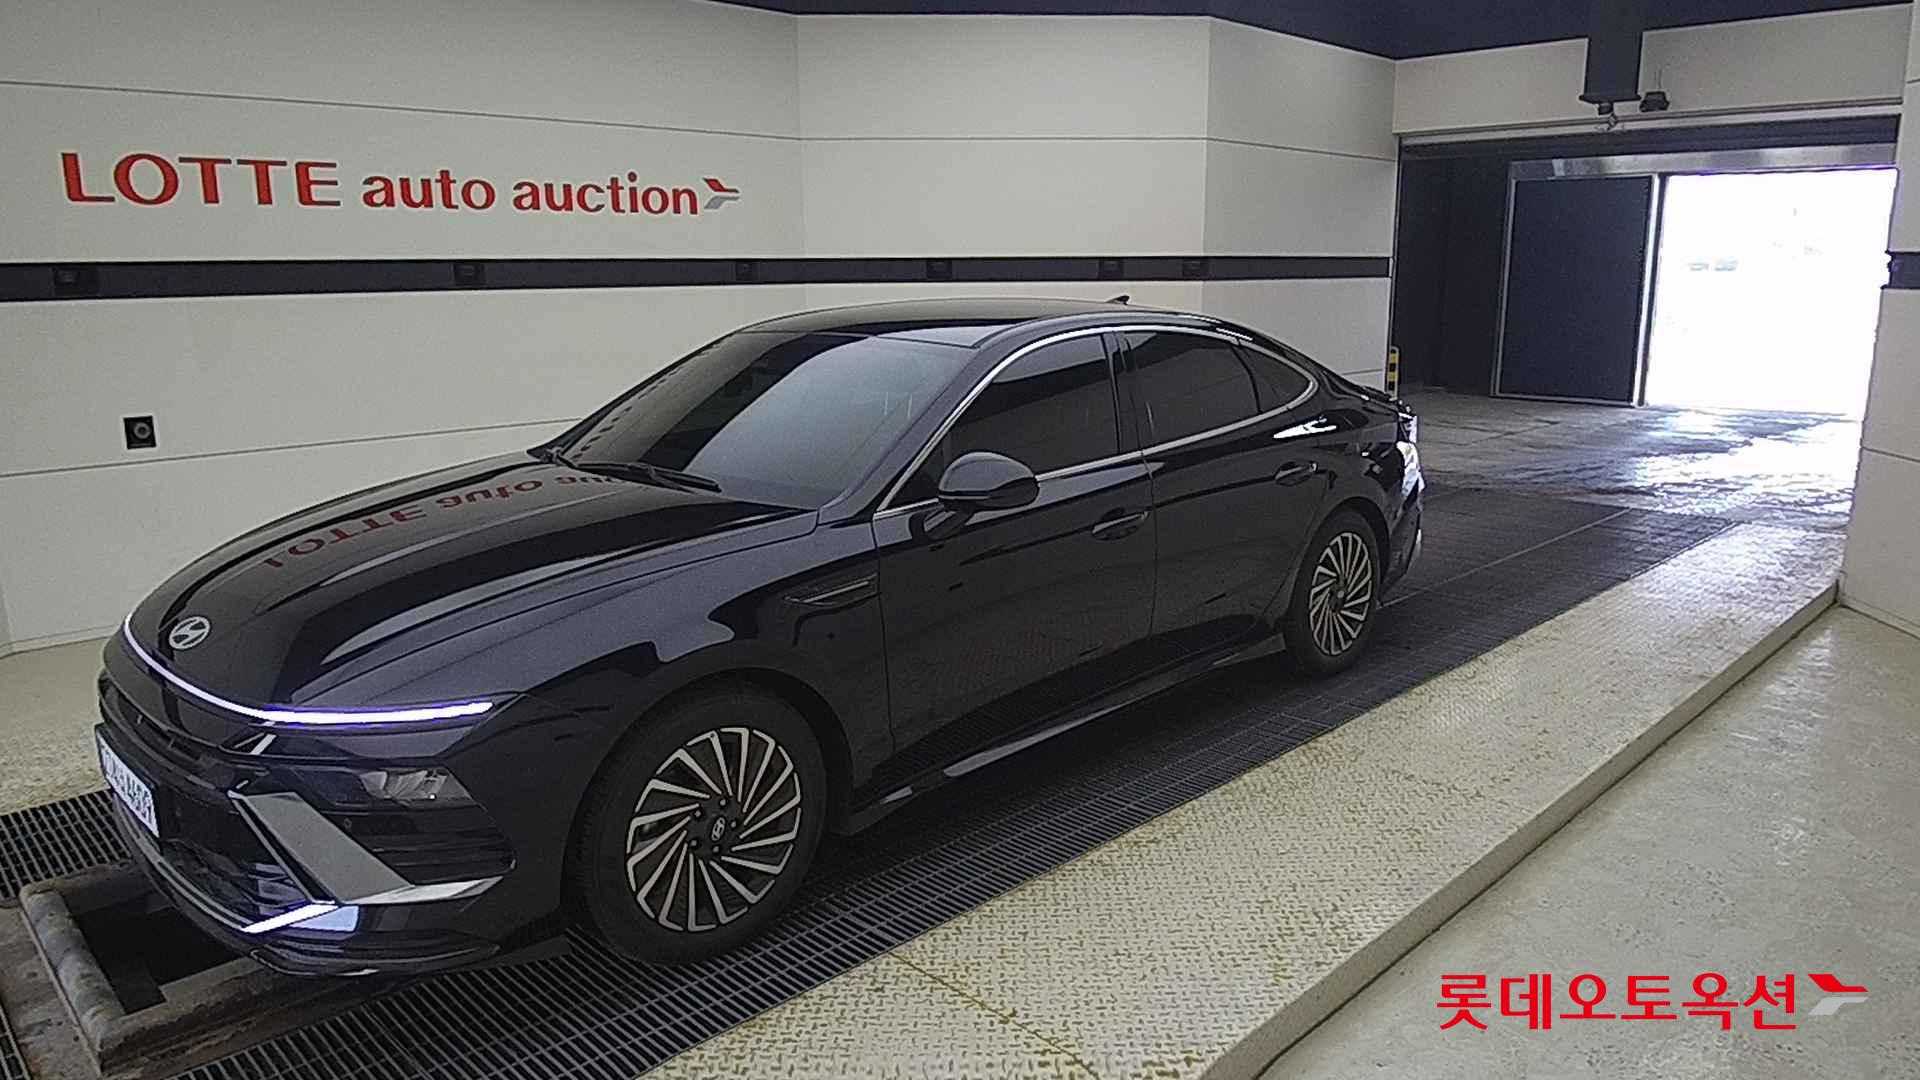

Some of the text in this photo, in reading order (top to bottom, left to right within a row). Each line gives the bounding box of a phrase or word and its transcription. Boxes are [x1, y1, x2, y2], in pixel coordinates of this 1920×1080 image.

[61, 152, 699, 216] LOTTE auto auction
